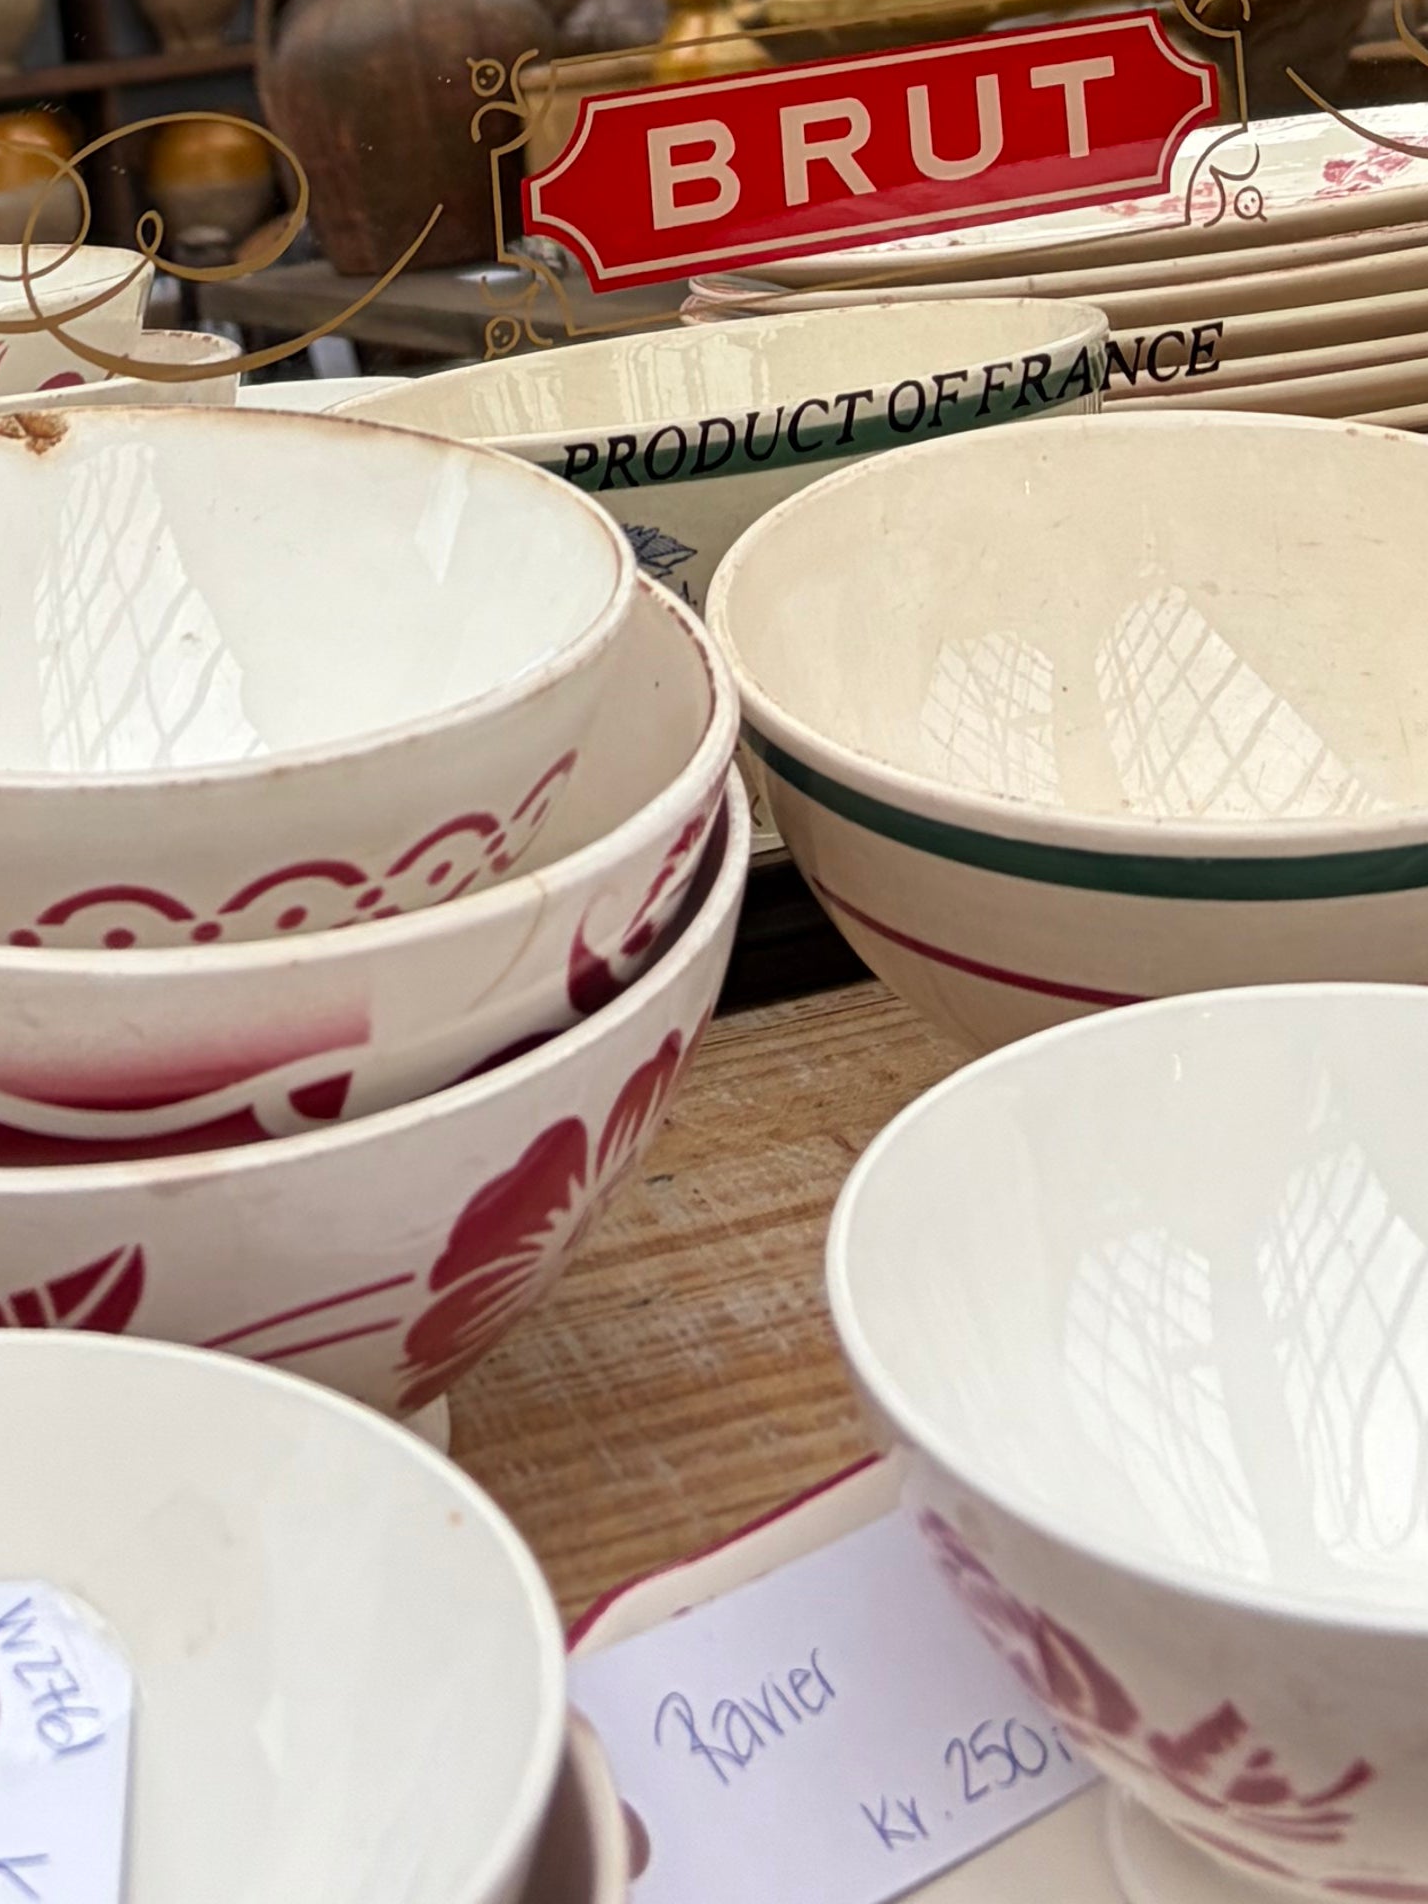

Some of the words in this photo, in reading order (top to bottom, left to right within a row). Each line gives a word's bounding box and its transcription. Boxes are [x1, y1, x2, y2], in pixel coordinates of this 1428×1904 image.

[646, 54, 1116, 231] BRUT
[562, 388, 874, 492] PRODUCT
[885, 369, 968, 435] OF
[973, 320, 1225, 418] FRANCE
[654, 1647, 836, 1786] Ravier
